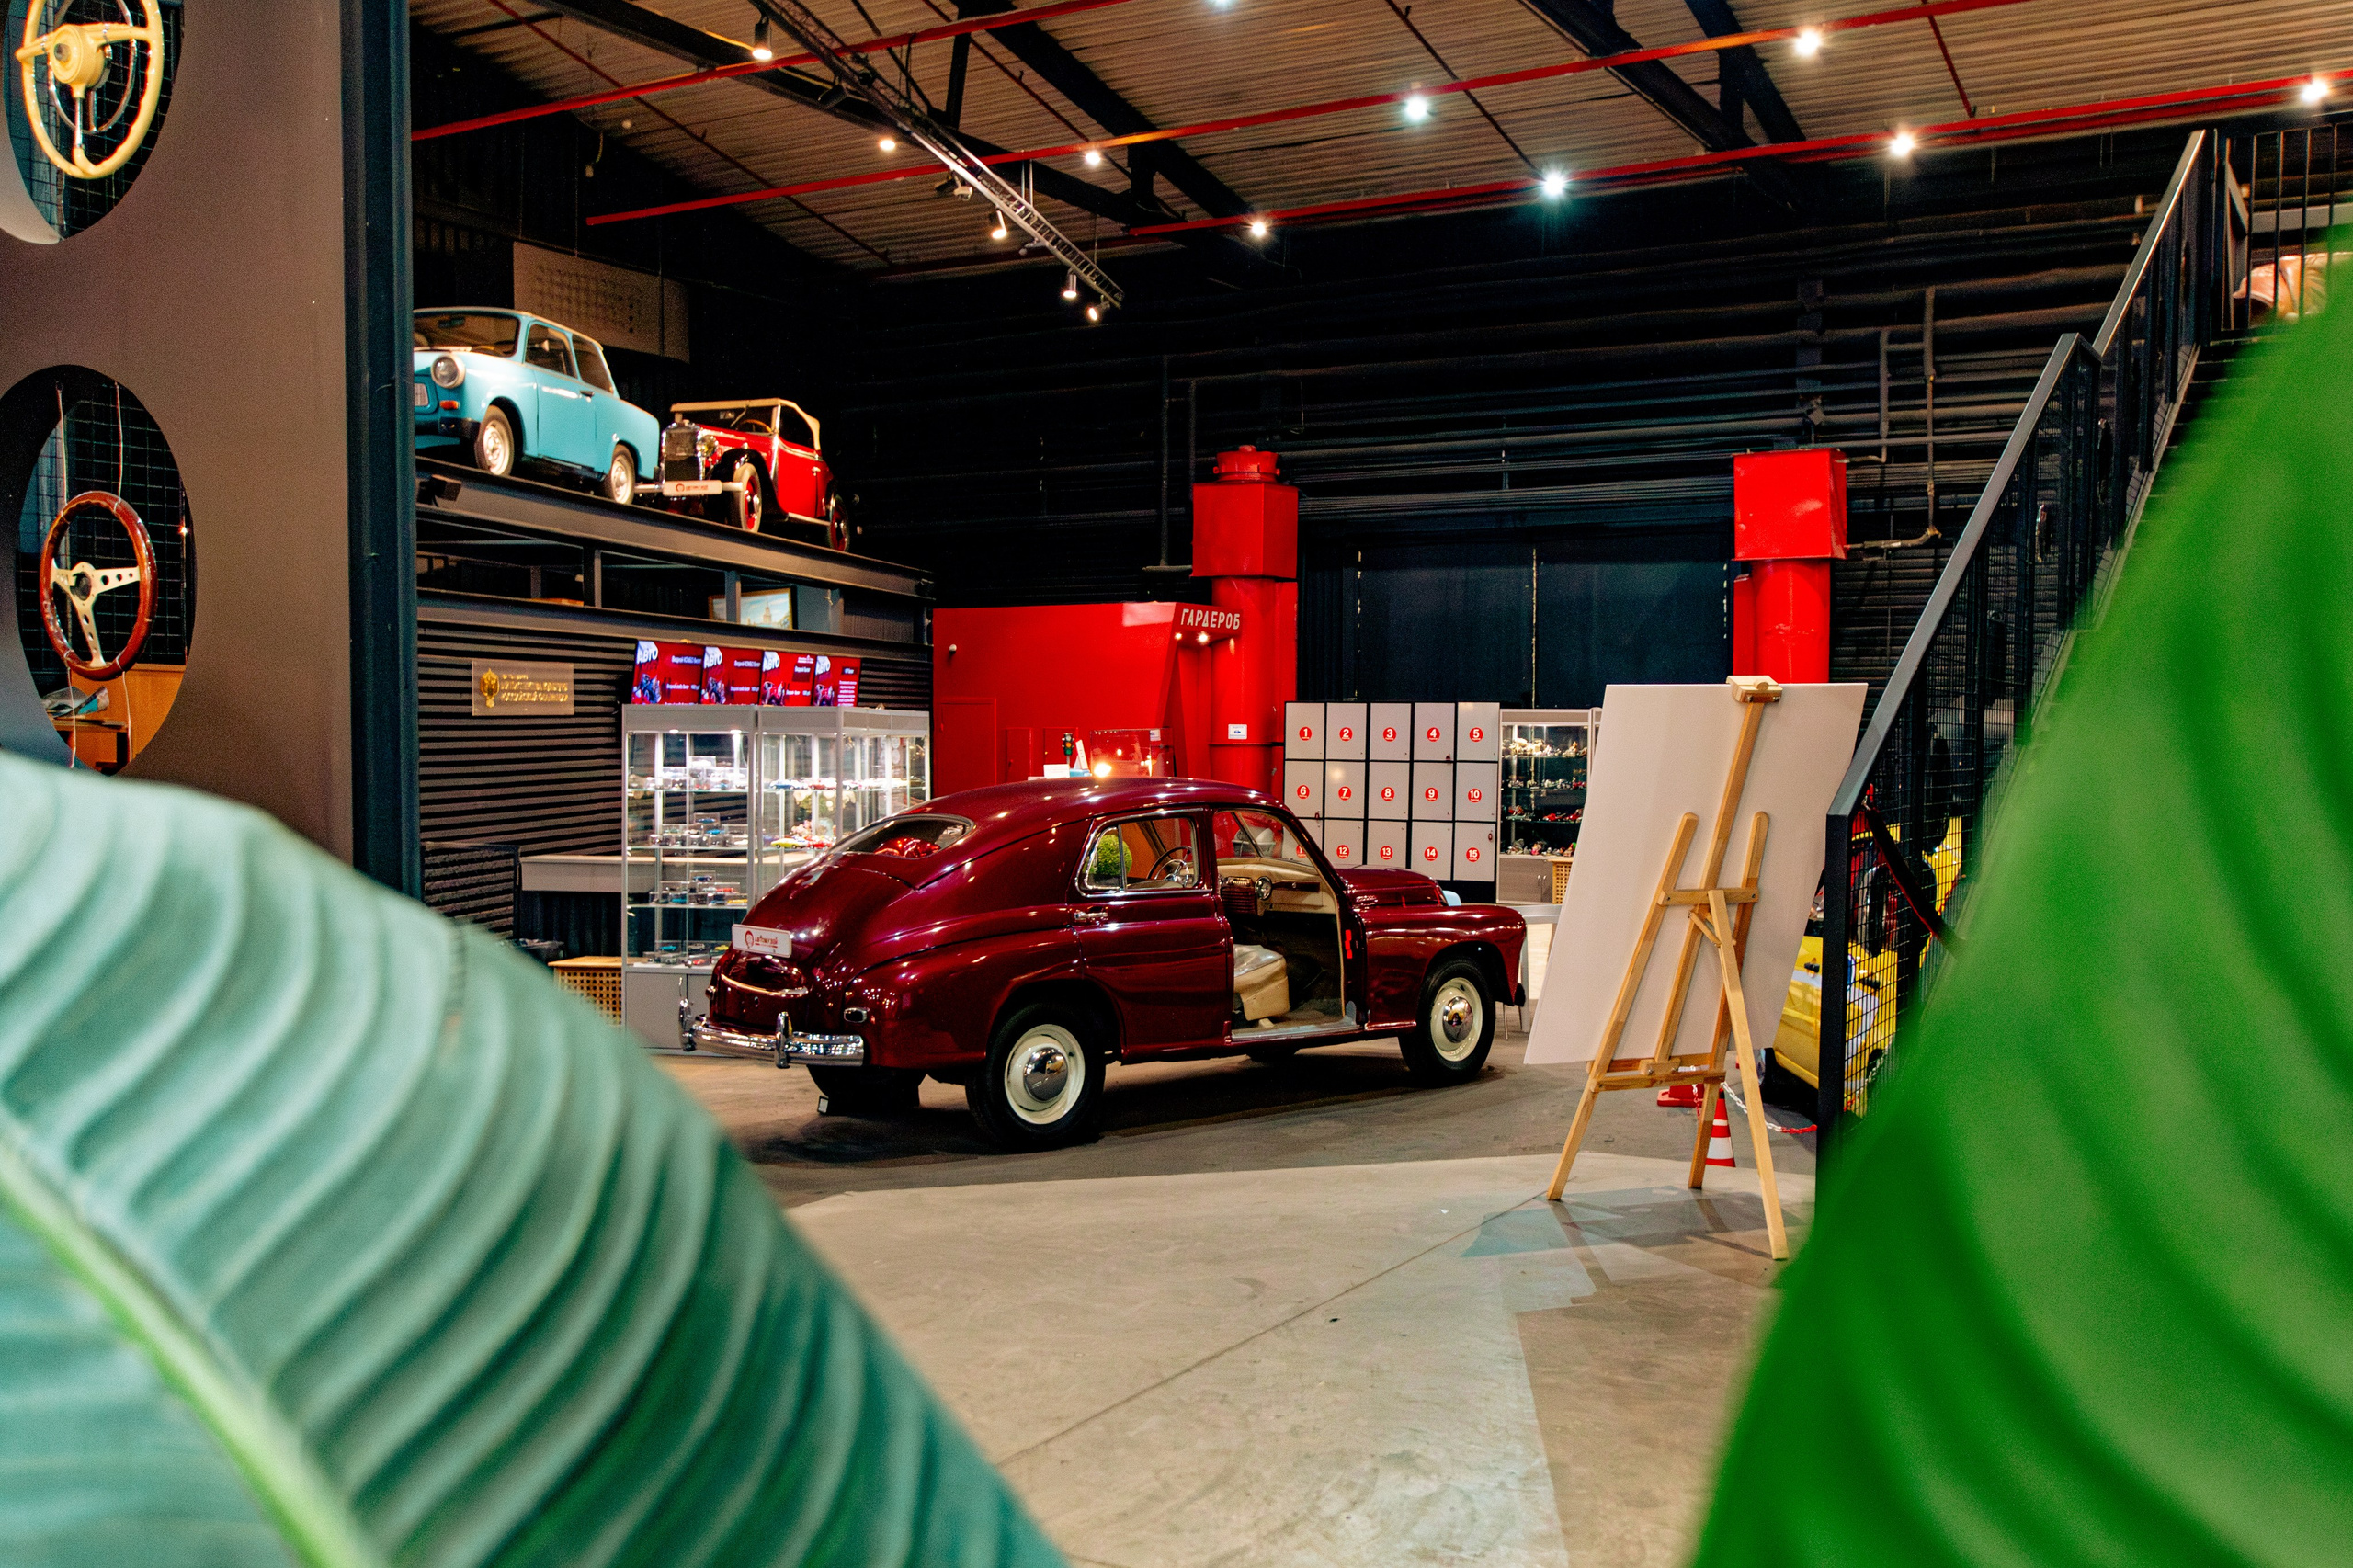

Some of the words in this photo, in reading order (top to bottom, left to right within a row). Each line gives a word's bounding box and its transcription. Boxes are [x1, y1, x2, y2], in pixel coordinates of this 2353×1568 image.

[1180, 608, 1241, 630] ГАРДЕРОБ
[636, 646, 659, 665] АВТО
[1303, 728, 1308, 737] 1
[1343, 728, 1349, 738] 2
[1386, 728, 1393, 738] 3
[1429, 728, 1438, 738] 4
[1472, 728, 1480, 738] 5
[1300, 786, 1307, 796] 6
[1342, 788, 1348, 797] 7
[1384, 788, 1392, 798] 8
[1427, 789, 1436, 798] 9
[1470, 790, 1480, 799] 10
[1338, 846, 1347, 855] 12
[1381, 847, 1392, 856] 13
[1426, 848, 1437, 858] 14
[1468, 849, 1478, 858] 15
